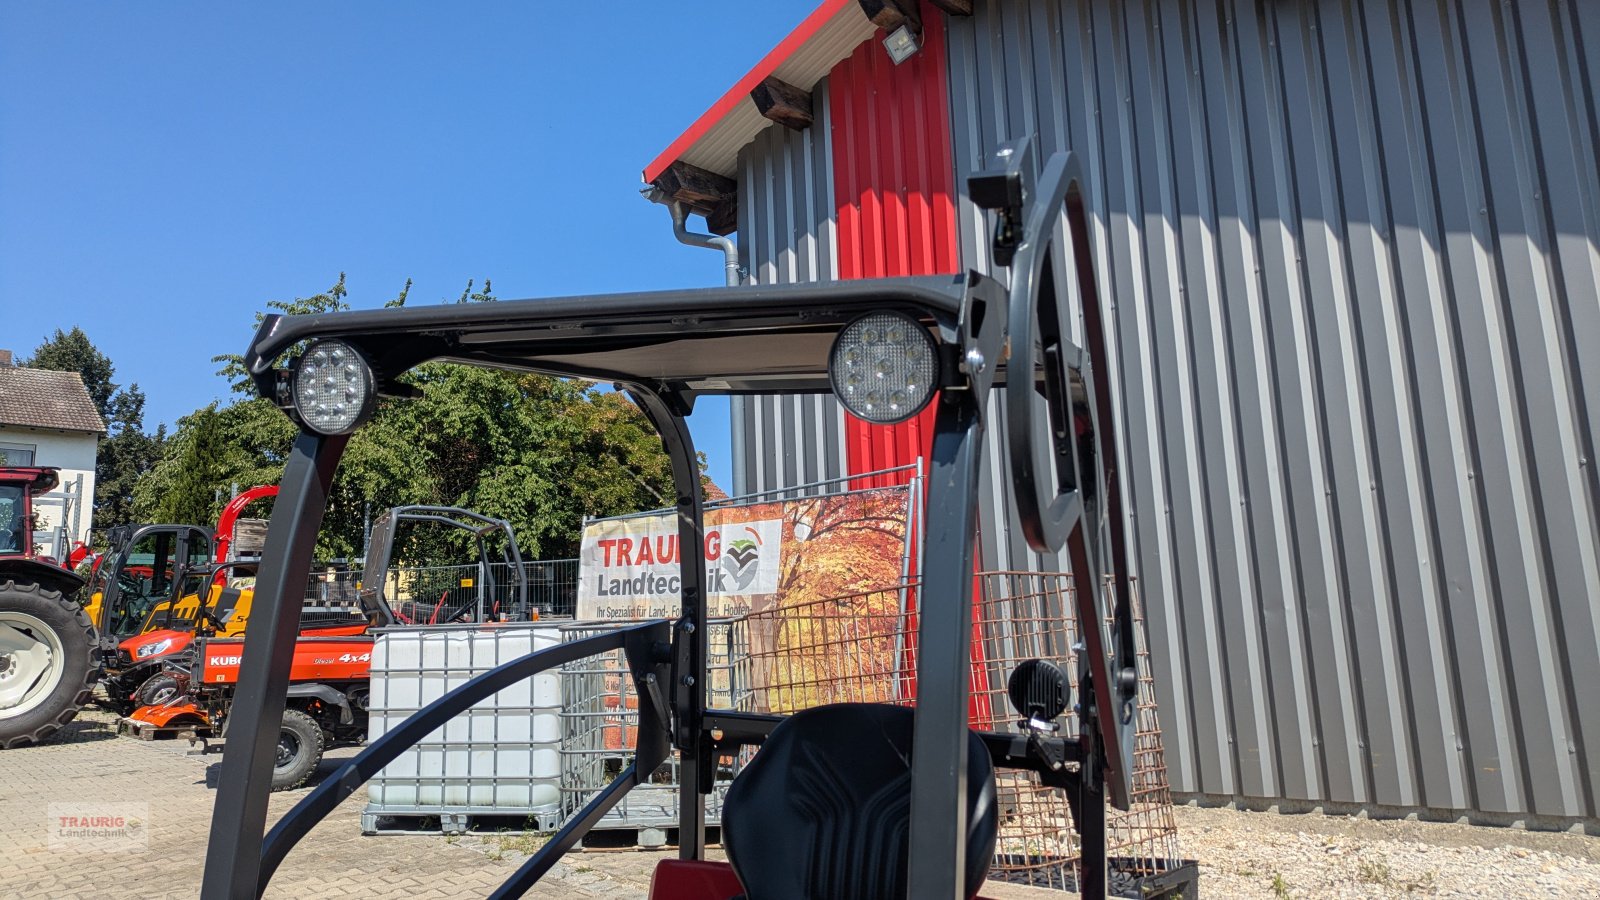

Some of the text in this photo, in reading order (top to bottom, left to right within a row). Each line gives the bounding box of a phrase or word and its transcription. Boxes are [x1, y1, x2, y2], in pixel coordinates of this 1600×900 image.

[598, 530, 720, 567] TRAUG
[597, 568, 727, 596] Landtecik
[607, 605, 635, 619] Spezialist
[339, 653, 371, 663] 4x4
